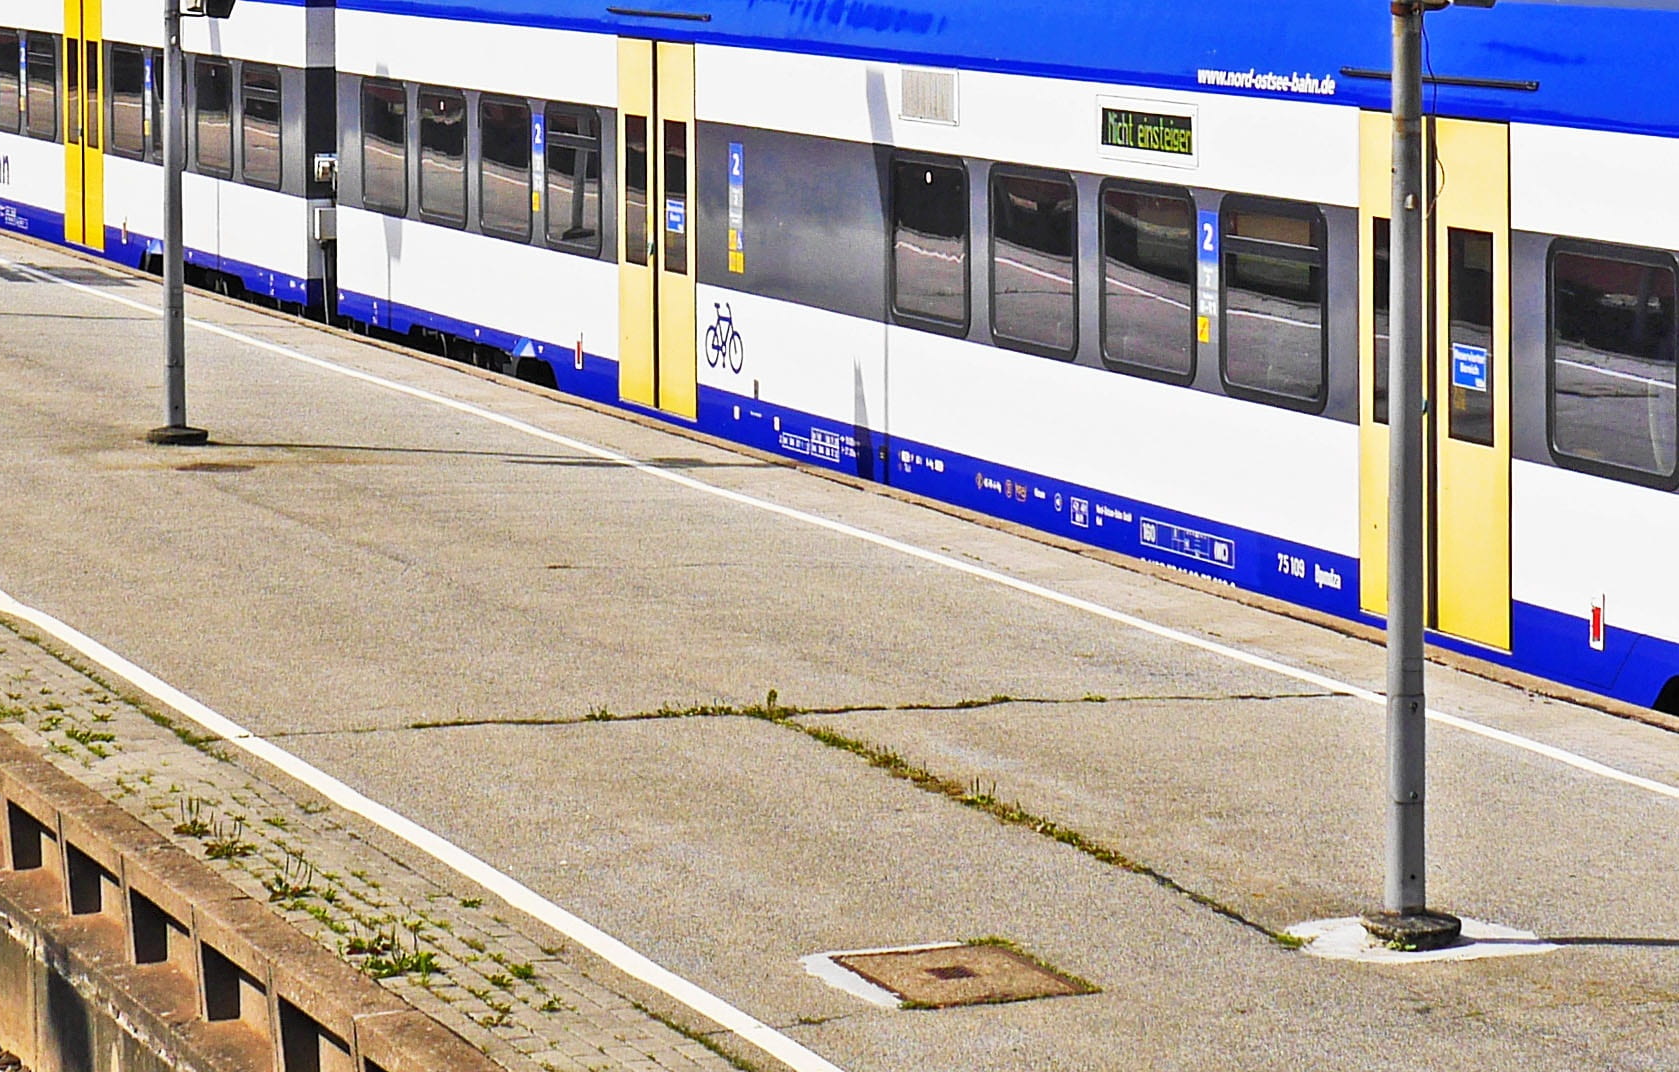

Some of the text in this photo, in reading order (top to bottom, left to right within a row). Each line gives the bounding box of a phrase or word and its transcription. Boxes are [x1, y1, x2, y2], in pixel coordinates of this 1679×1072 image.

[1197, 68, 1336, 95] www.nord-ostsee-bahn.de
[534, 123, 542, 144] 2
[1108, 111, 1134, 146] Nicht
[732, 153, 740, 176] 2
[1203, 222, 1214, 251] 2
